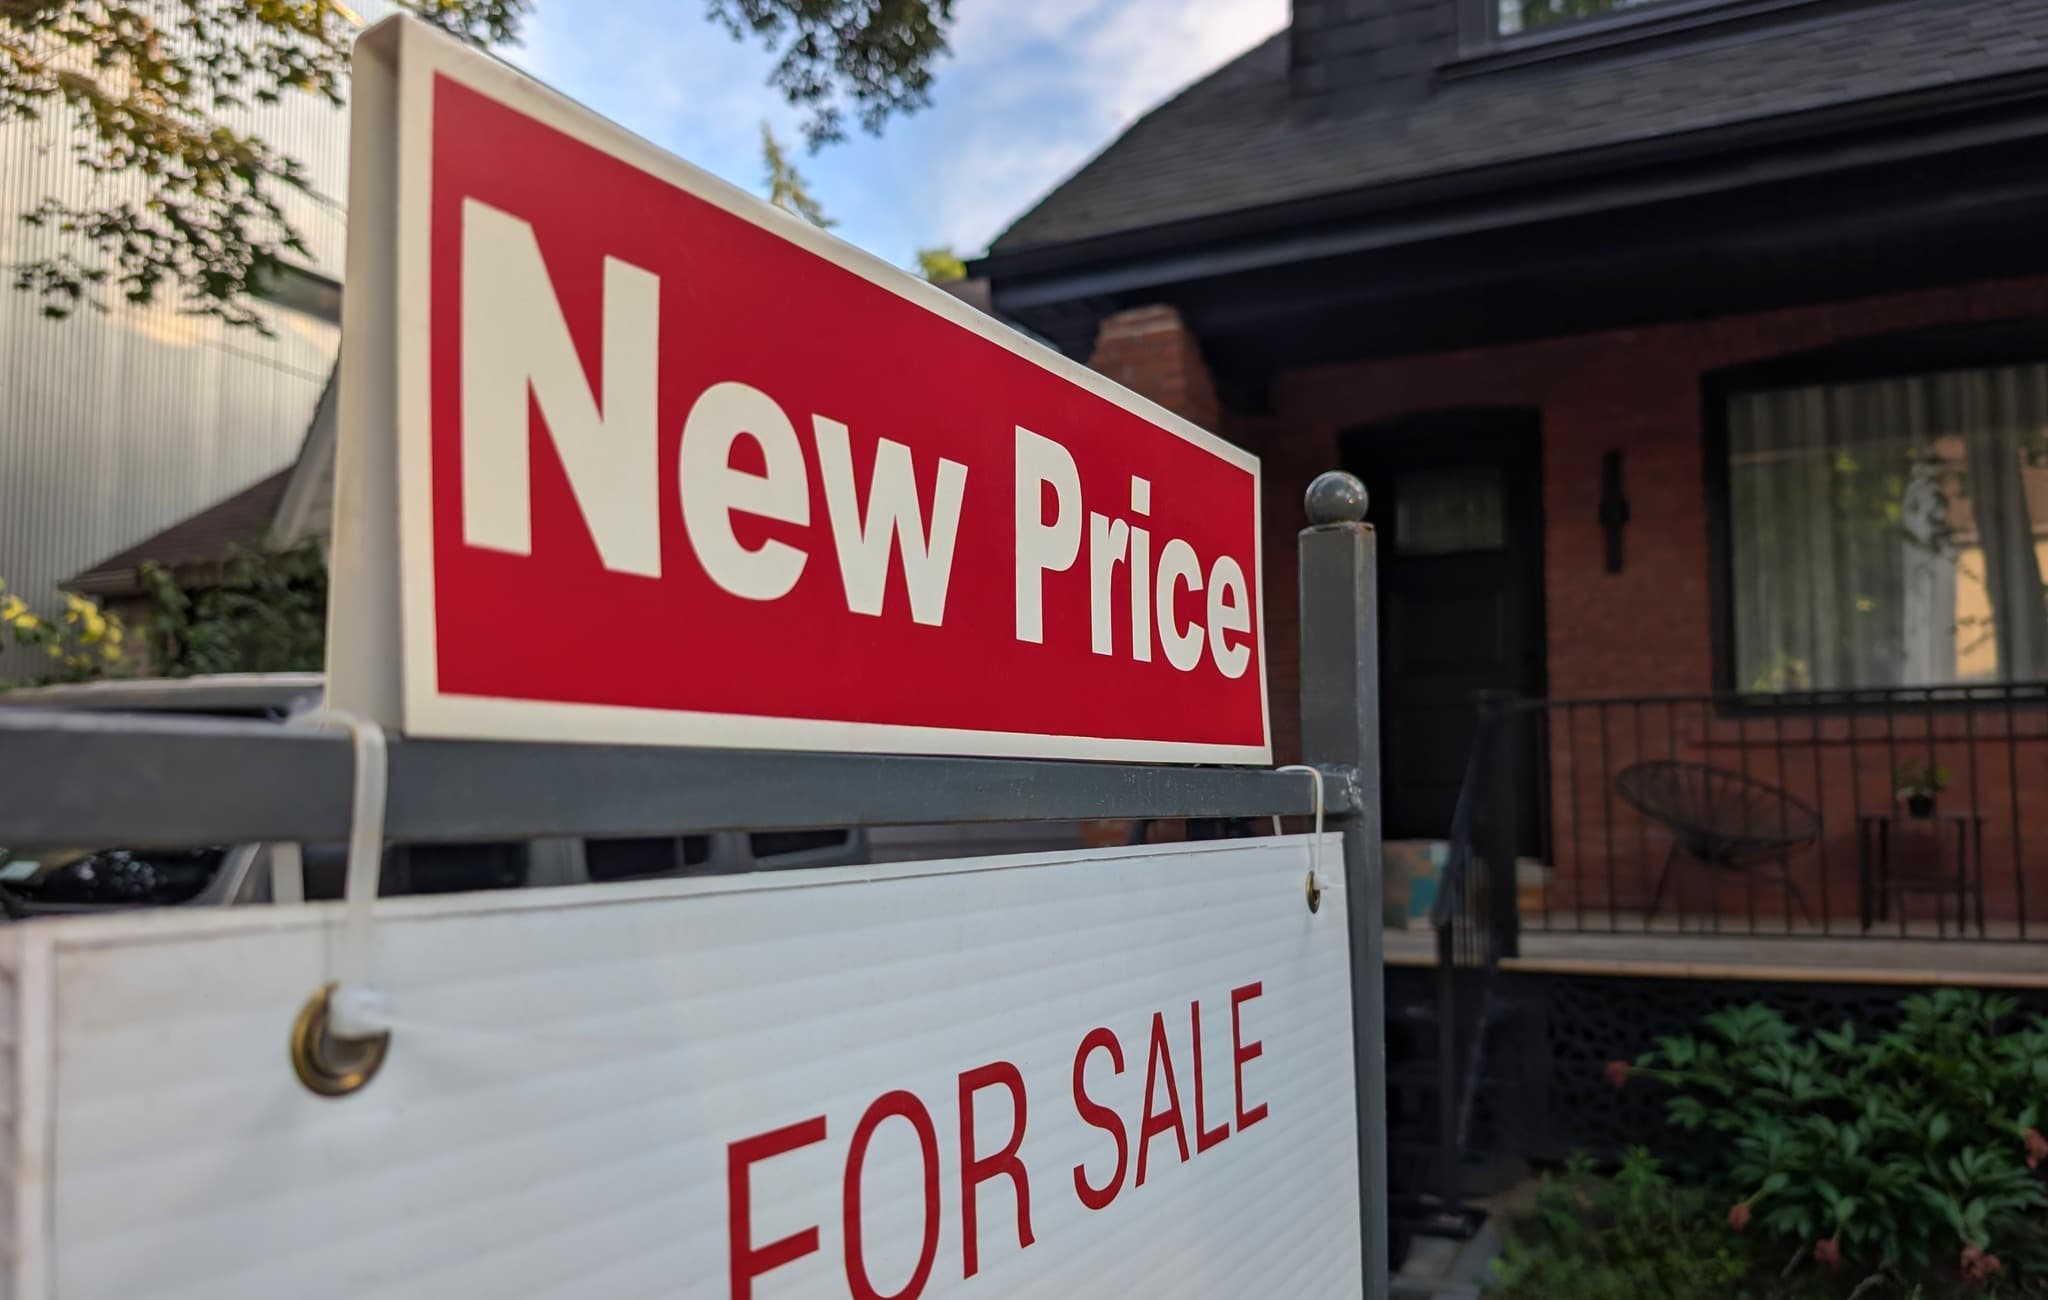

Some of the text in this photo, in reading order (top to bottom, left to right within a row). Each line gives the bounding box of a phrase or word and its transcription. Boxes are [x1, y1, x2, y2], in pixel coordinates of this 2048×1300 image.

[461, 197, 1252, 679] New Price
[727, 980, 1269, 1300] FOR SALE
